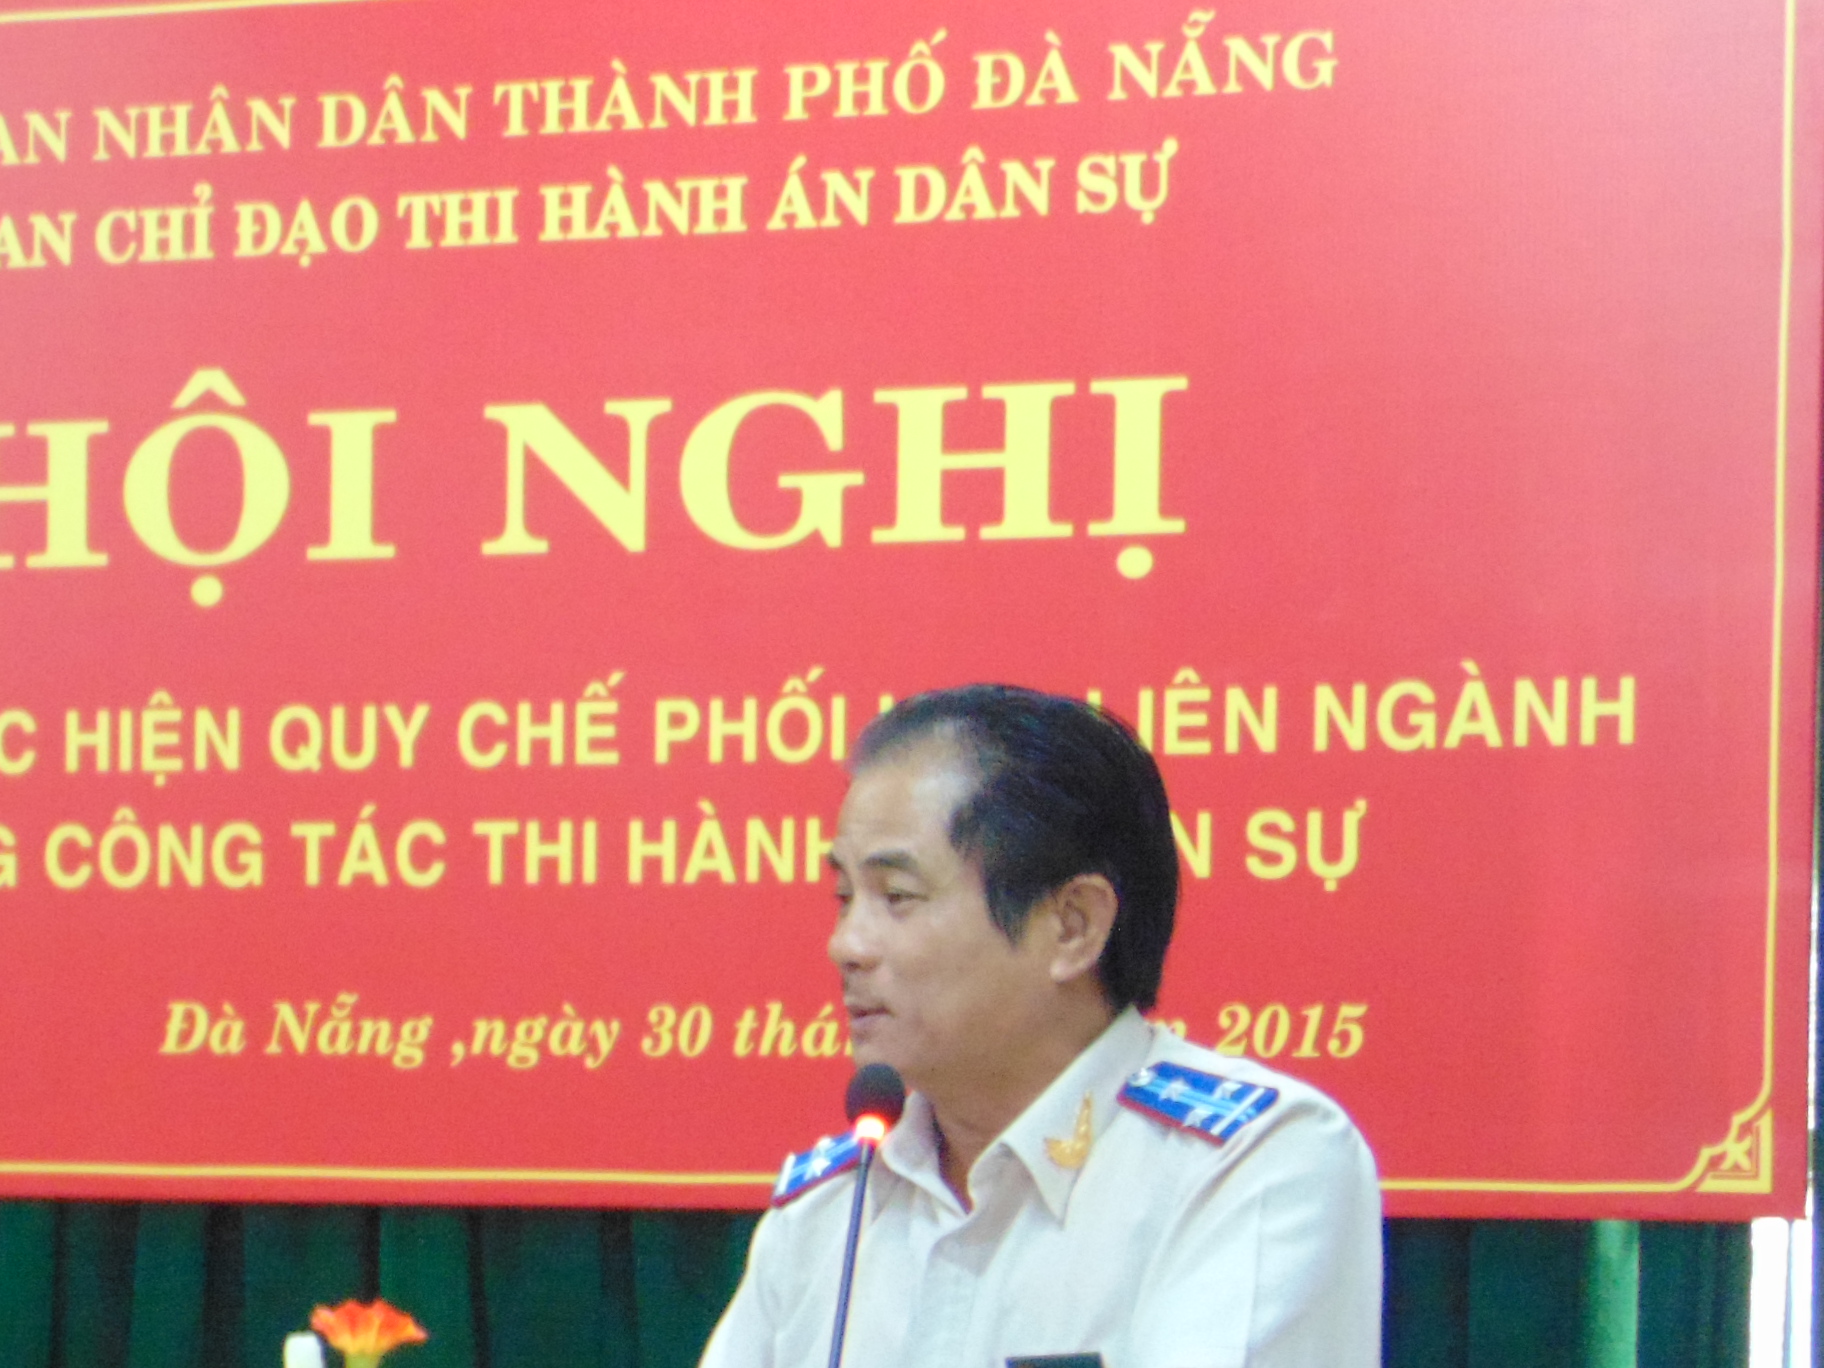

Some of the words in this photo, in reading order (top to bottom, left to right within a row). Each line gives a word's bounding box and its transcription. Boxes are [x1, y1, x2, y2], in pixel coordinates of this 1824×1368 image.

[95, 84, 297, 159] NHÂN
[319, 73, 472, 147] DÂN
[494, 59, 758, 136] THÀNH
[784, 28, 948, 121] PHỐ
[973, 31, 1080, 109] ĐÀ
[1109, 10, 1337, 99] NẴNG
[95, 182, 215, 264] CHỈ
[235, 196, 380, 266] ĐẠO
[397, 187, 519, 249] THI
[539, 165, 749, 241] HÀNH
[768, 154, 876, 230] ÁN
[894, 144, 1056, 224] DÂN
[1077, 137, 1180, 224] SỰ
[481, 375, 1189, 579] NGHỊ
[65, 690, 242, 787] HIỆN
[269, 703, 431, 771] QUY
[458, 671, 624, 770] CHẾ
[655, 666, 848, 764] PHỐI
[1087, 667, 1279, 755] IÊN
[1314, 660, 1636, 751] NGÀNH
[45, 806, 265, 891] CÔNG
[290, 804, 447, 888] TÁC
[474, 818, 599, 885] THI
[1245, 798, 1368, 892] SỰ
[160, 1000, 245, 1055] Đà
[641, 1004, 714, 1058] 30
[734, 1001, 854, 1058] thá
[1217, 1002, 1368, 1058] 2015
